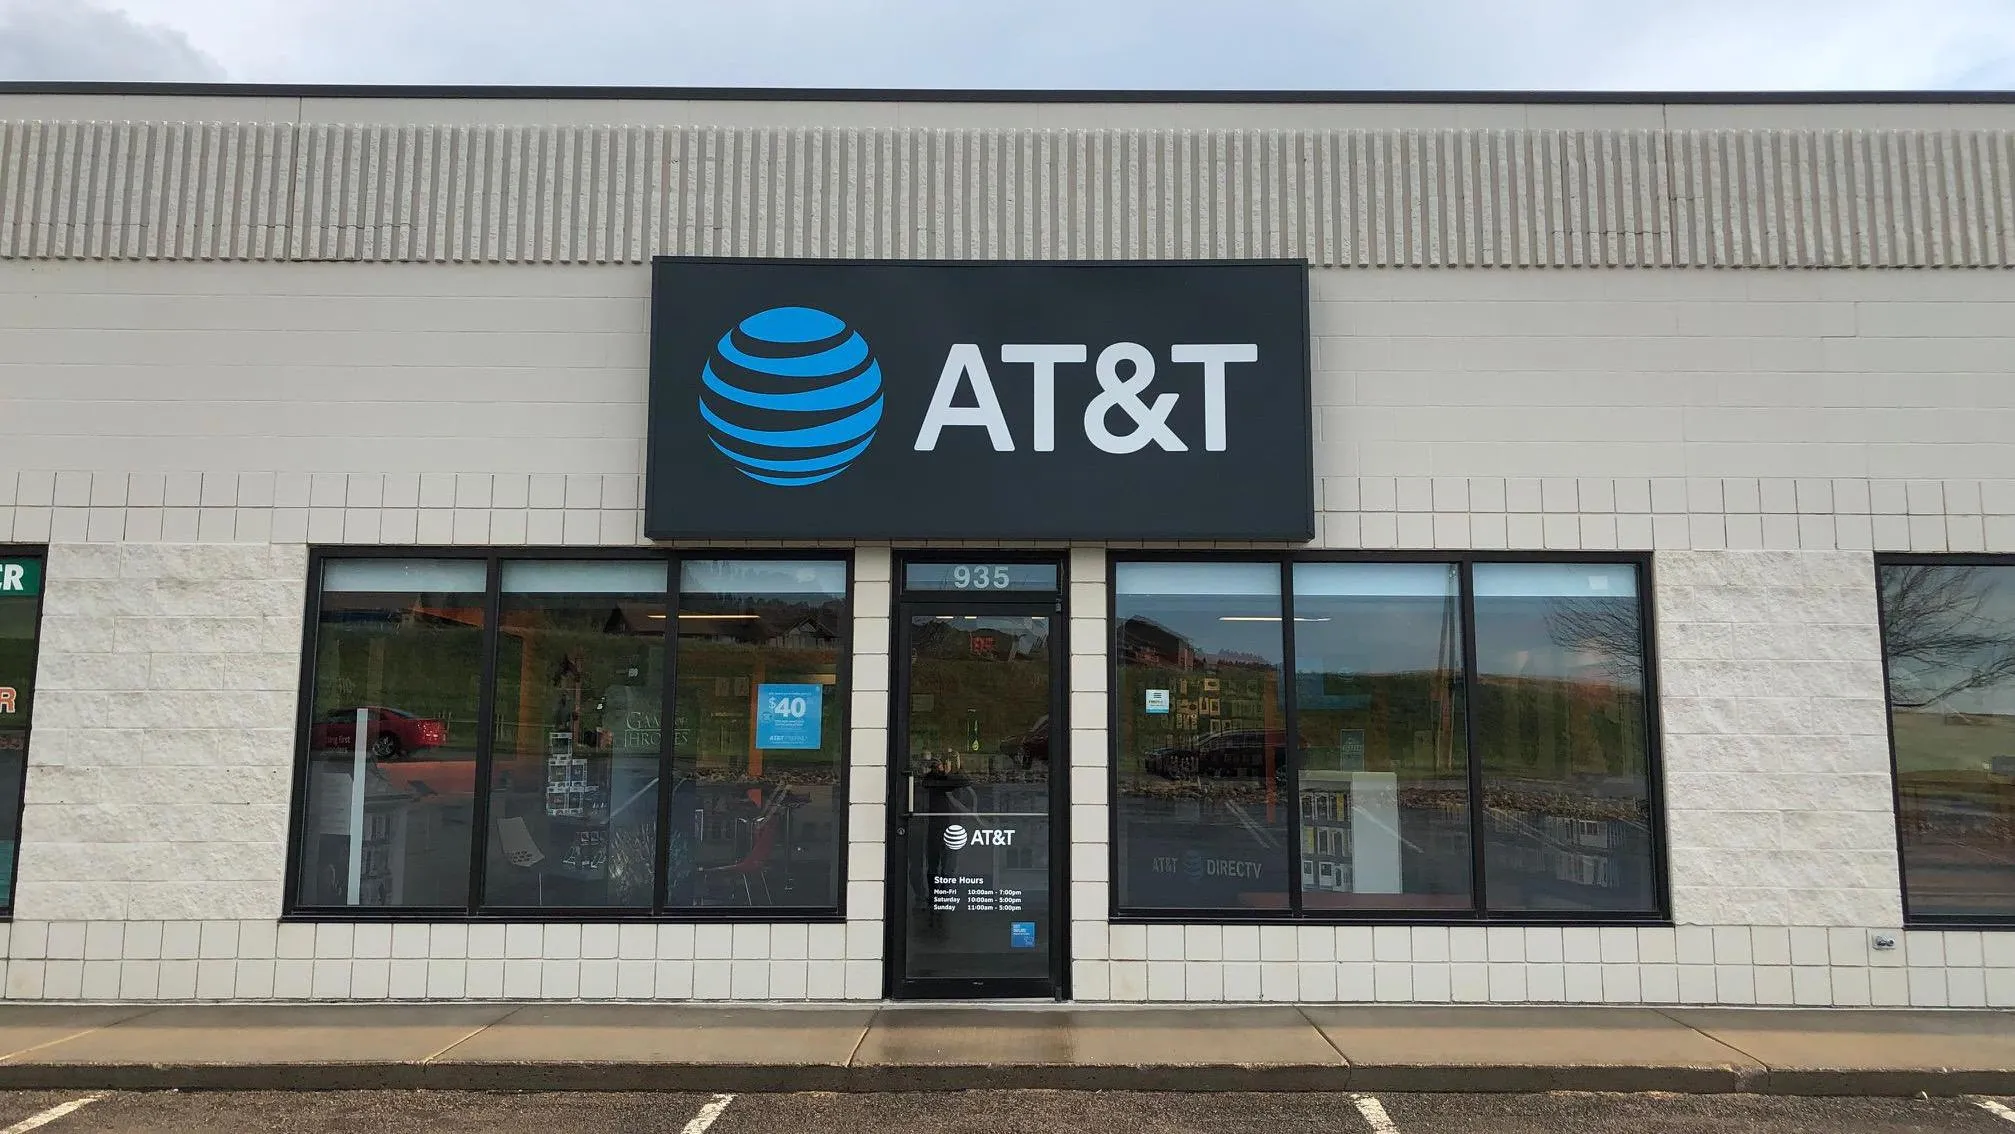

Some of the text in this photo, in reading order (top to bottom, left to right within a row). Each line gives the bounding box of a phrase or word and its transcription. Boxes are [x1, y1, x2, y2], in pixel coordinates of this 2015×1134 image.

[913, 341, 1258, 455] AT&T
[0, 564, 24, 591] R
[953, 565, 1010, 589] 935
[769, 697, 806, 718] $40
[624, 730, 689, 747] THROES
[970, 829, 1015, 846] AT&T
[1152, 857, 1262, 879] AT&T DIRECTV
[934, 876, 984, 885] Store Hours
[933, 888, 957, 896] Mon-Fri
[999, 889, 1022, 898] 7:00pm
[933, 896, 961, 904] Saturday
[933, 904, 956, 912] Sunday
